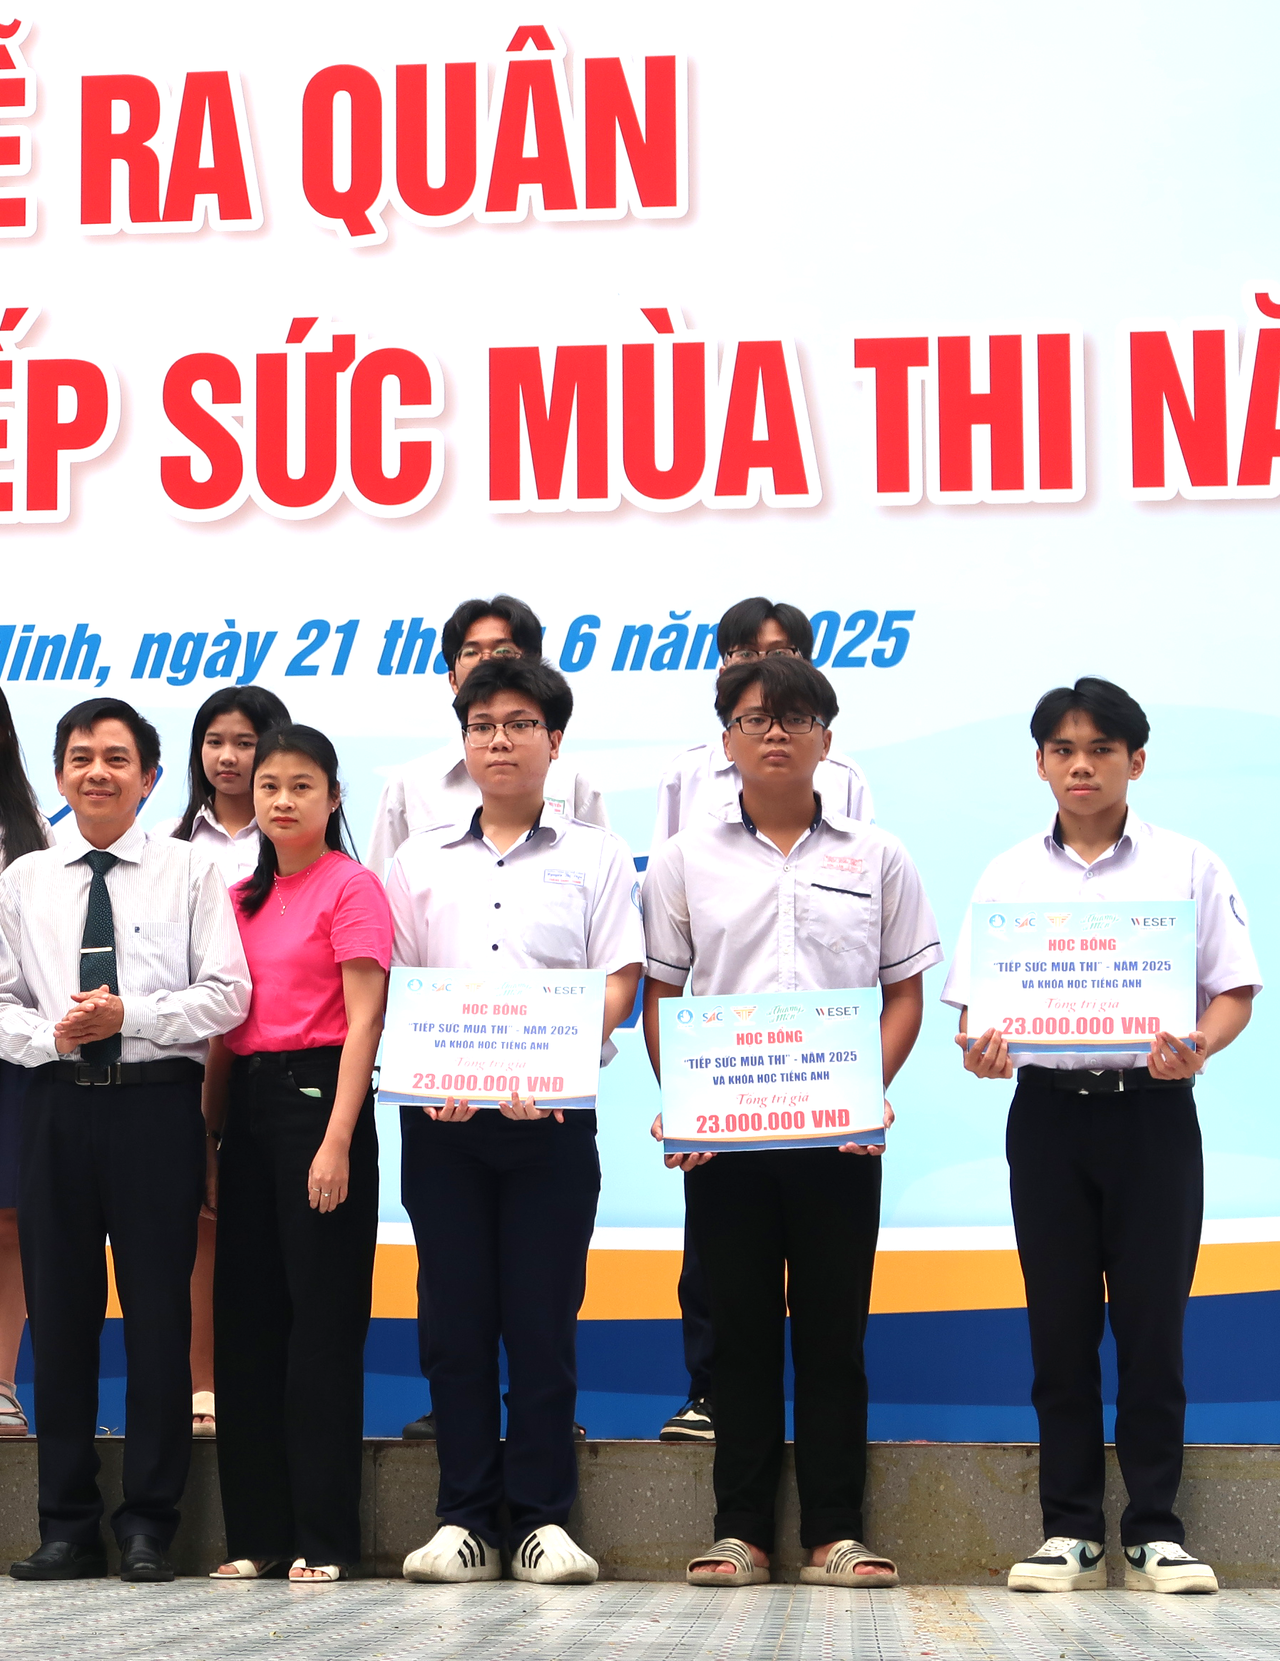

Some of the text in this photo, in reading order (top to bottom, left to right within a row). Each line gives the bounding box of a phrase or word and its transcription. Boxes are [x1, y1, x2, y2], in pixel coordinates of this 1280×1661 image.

[80, 70, 253, 225] RA
[302, 25, 678, 237] QUÂN
[161, 317, 433, 510] SỨC
[488, 307, 810, 501] MÙA
[854, 333, 1073, 493] THI
[131, 618, 279, 687] ngày
[284, 618, 361, 677] 21
[559, 614, 601, 673] 6
[809, 609, 916, 669] 025
[1142, 961, 1171, 971] 2025
[1122, 979, 1142, 988] ANH
[1002, 1017, 1160, 1035] 23.000.000 VNĐ
[737, 1027, 803, 1047] HỌC BỔNG
[715, 1055, 736, 1068] SỨC
[740, 1054, 764, 1067] MÙA
[801, 1052, 825, 1064] NĂM
[829, 1051, 857, 1062] 2025
[412, 1073, 564, 1092] 23.000.000 VNĐ
[713, 1070, 830, 1085] VÀ KHÓA HỌC TIẾNG ANH
[696, 1109, 850, 1134] 23.000.000 VNĐ
